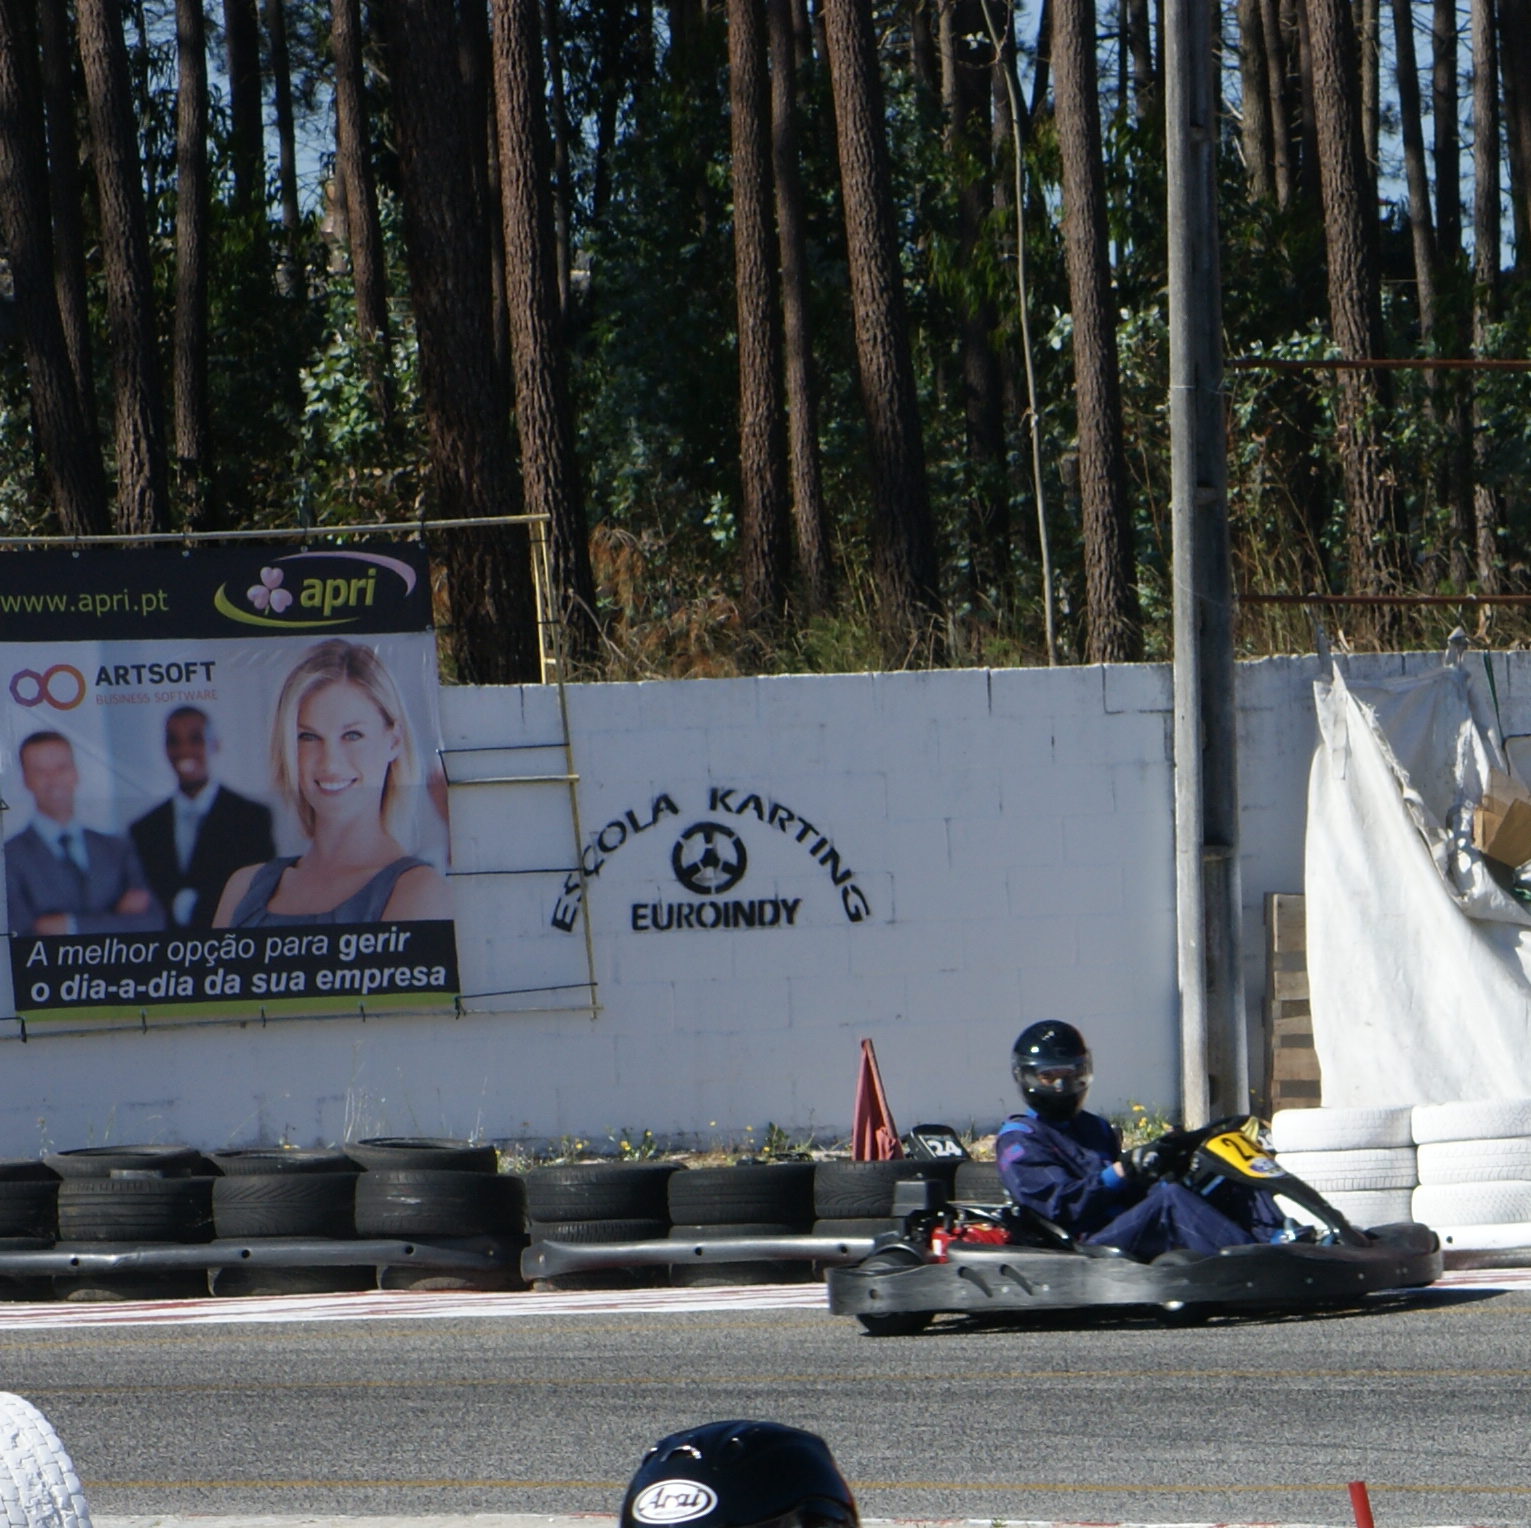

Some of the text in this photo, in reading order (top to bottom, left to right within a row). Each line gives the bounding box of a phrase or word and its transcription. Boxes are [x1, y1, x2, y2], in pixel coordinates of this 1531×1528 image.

[1, 588, 169, 617] www.apri.pt
[300, 568, 377, 617] apri
[94, 661, 216, 687] ARTSOFT
[155, 689, 218, 703] SOFTWARE
[551, 787, 871, 933] ESCOLA KARTING
[631, 898, 802, 932] EUROINDY
[26, 927, 411, 968] A melhor opção para gerir
[31, 965, 446, 1002] o dia-a-dia da sua empresa
[927, 1139, 963, 1157] 24
[648, 1486, 703, 1511] Arai
